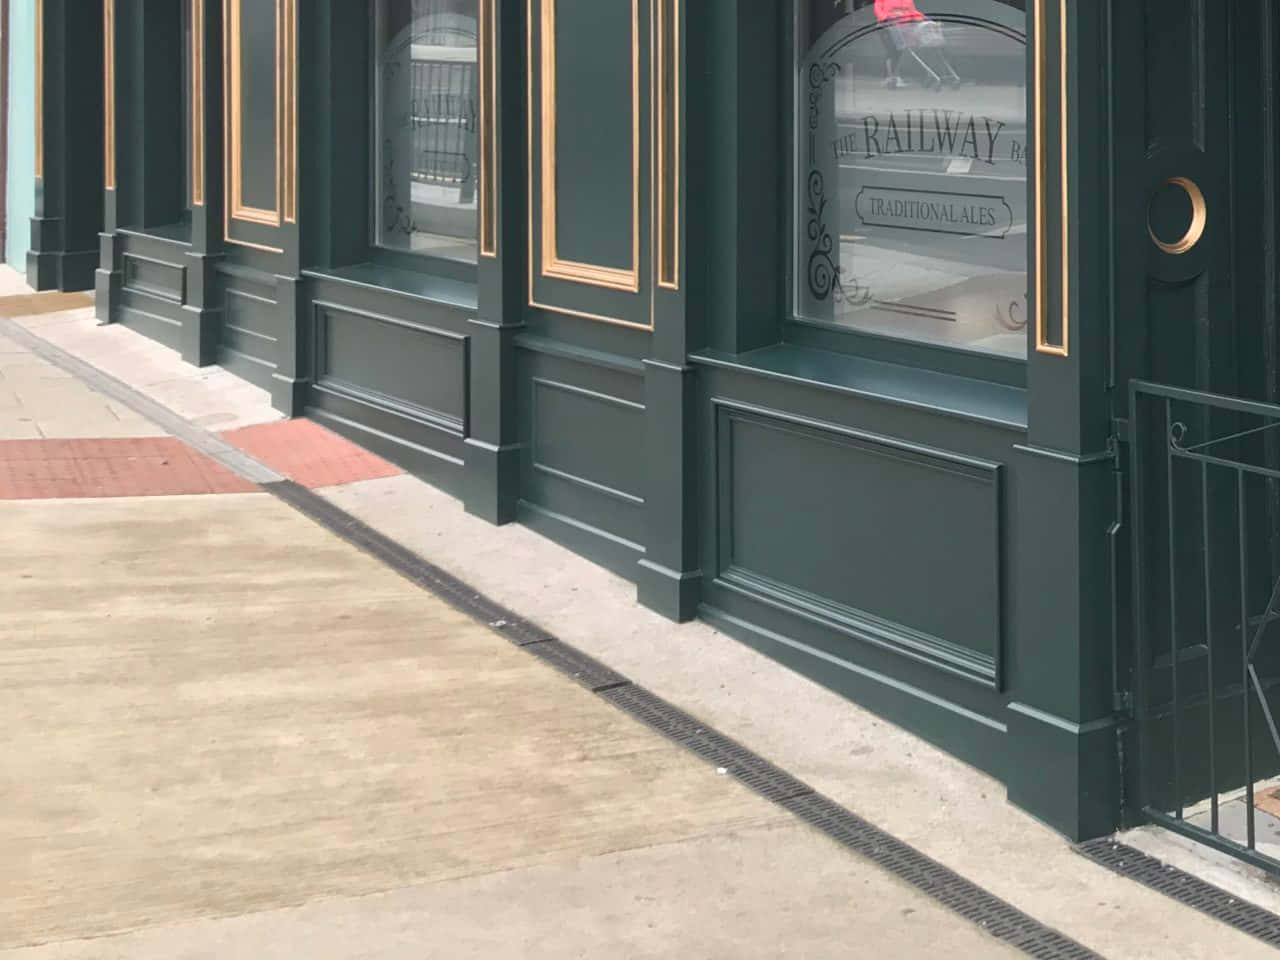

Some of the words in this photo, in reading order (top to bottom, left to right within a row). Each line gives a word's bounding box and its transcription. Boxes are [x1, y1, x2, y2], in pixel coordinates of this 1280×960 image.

[833, 133, 857, 160] THE
[862, 109, 1006, 166] RAILWAY
[869, 197, 959, 224] TRADITIONAL
[962, 205, 996, 226] ALES
